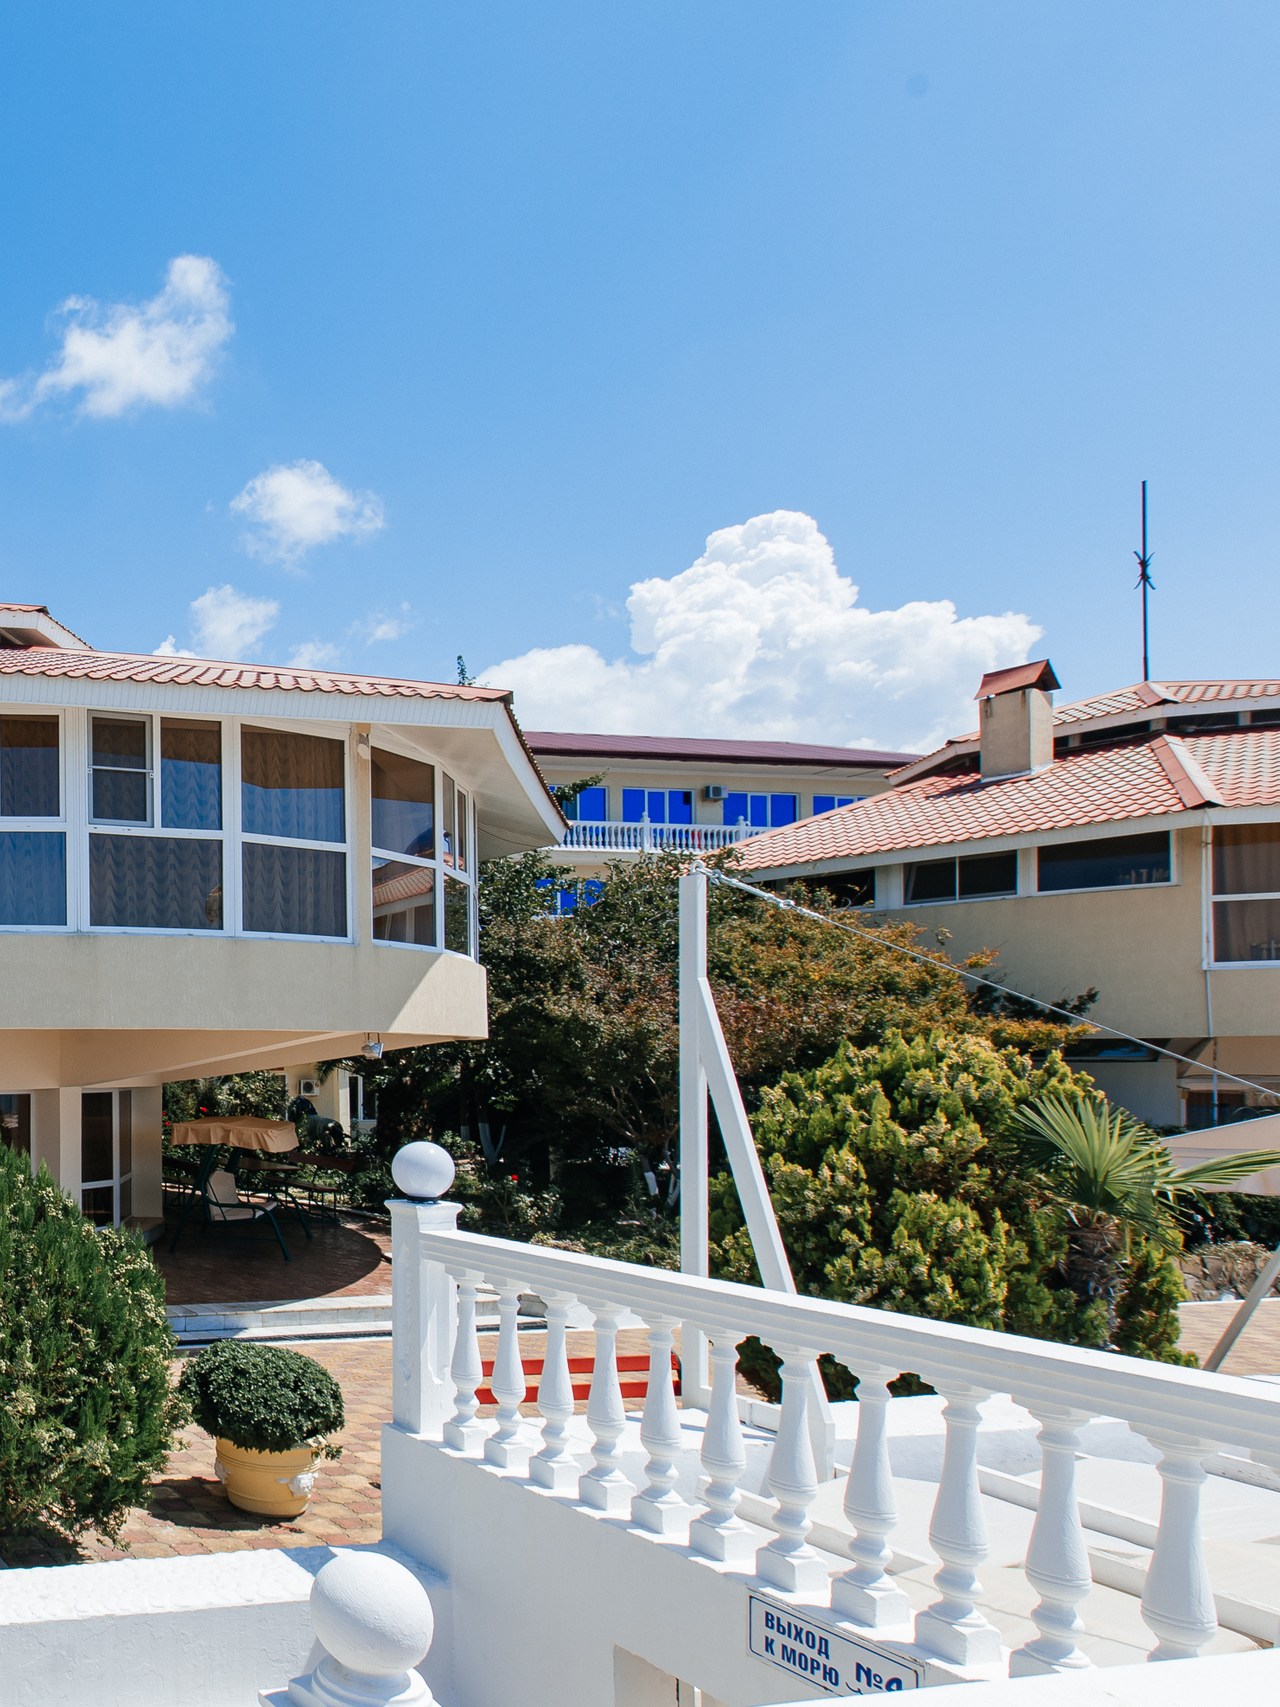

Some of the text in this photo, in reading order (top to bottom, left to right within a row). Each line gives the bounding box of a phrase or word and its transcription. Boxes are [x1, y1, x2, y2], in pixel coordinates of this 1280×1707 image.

[765, 1610, 830, 1660] ВЫХОД
[765, 1635, 839, 1687] К МОРЮ
